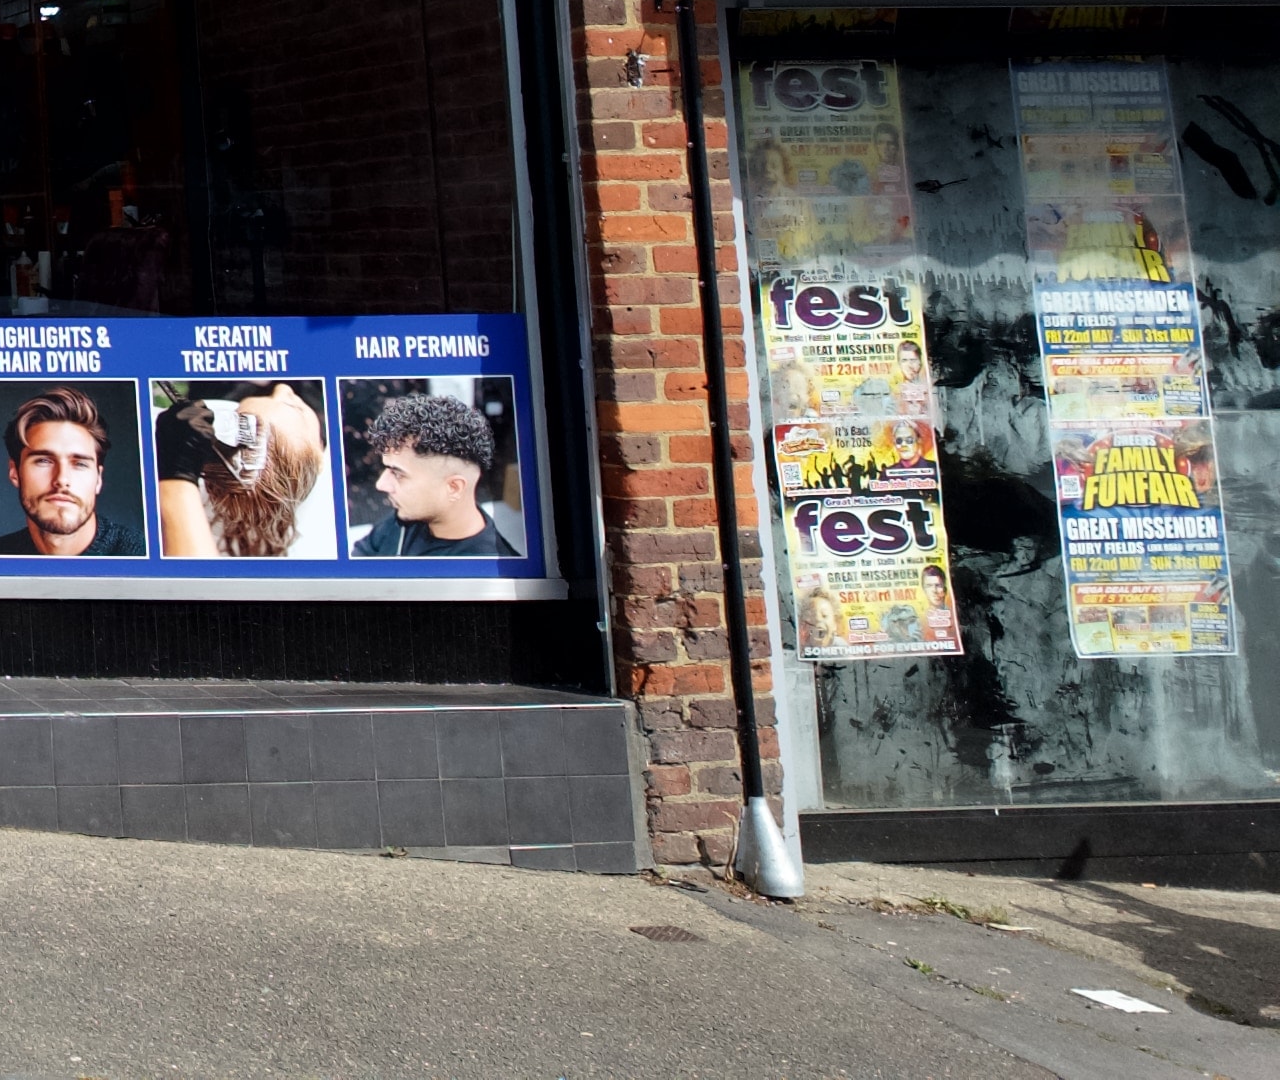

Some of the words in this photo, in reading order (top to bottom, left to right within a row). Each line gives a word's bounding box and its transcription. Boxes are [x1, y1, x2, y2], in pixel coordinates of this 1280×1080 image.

[748, 59, 889, 110] fest
[1017, 71, 1068, 93] GREAT
[1069, 70, 1161, 93] MISSENDEN
[770, 276, 912, 328] fest
[1041, 291, 1090, 313] GREAT
[1093, 290, 1190, 313] MISSENDEN
[1077, 315, 1117, 328] FIELDS
[96, 326, 112, 350] &
[194, 325, 273, 348] KERATIN
[1045, 329, 1062, 344] FRI
[1063, 328, 1091, 344] 22nd
[1092, 328, 1114, 343] MAY
[1121, 328, 1144, 343] SUN
[1144, 328, 1170, 343] 31st
[1170, 328, 1195, 343] MAY
[355, 336, 402, 359] HAIR
[405, 334, 491, 359] PERMING
[802, 345, 833, 356] GREAT
[835, 343, 895, 356] MISSENDEN
[45, 350, 102, 373] DYING
[180, 349, 290, 373] TREATMENT
[837, 363, 865, 376] 23rd
[850, 425, 870, 436] Bac
[836, 438, 849, 448] for
[850, 437, 873, 448] 2026
[1094, 446, 1177, 474] FAMILY
[1083, 470, 1201, 511] FUNFAIR
[825, 497, 852, 507] Great
[852, 496, 902, 506] Missenden
[794, 502, 937, 555] fest
[1066, 517, 1119, 541] GREAT
[1122, 515, 1218, 540] MISSENDEN
[1068, 542, 1102, 555] BURY
[1104, 541, 1145, 555] FIELDS
[1070, 557, 1088, 571] FRI
[1089, 556, 1118, 571] 22nd
[1119, 556, 1141, 571] MAY
[1150, 556, 1172, 570] SUN
[1173, 555, 1198, 570] 31st
[1198, 555, 1223, 570] MAY
[827, 572, 859, 584] GREAT
[861, 569, 920, 582] MISSENDEN
[840, 590, 861, 604] SAT
[863, 589, 890, 603] 23rd
[893, 588, 918, 602] MAY
[1105, 585, 1130, 594] DEAL
[1131, 585, 1151, 593] BUY
[1082, 594, 1105, 604] GET
[1118, 593, 1164, 603] TOKENS
[804, 643, 872, 656] SOMETHING
[873, 642, 895, 654] FOR
[895, 640, 957, 654] EVERYONE
